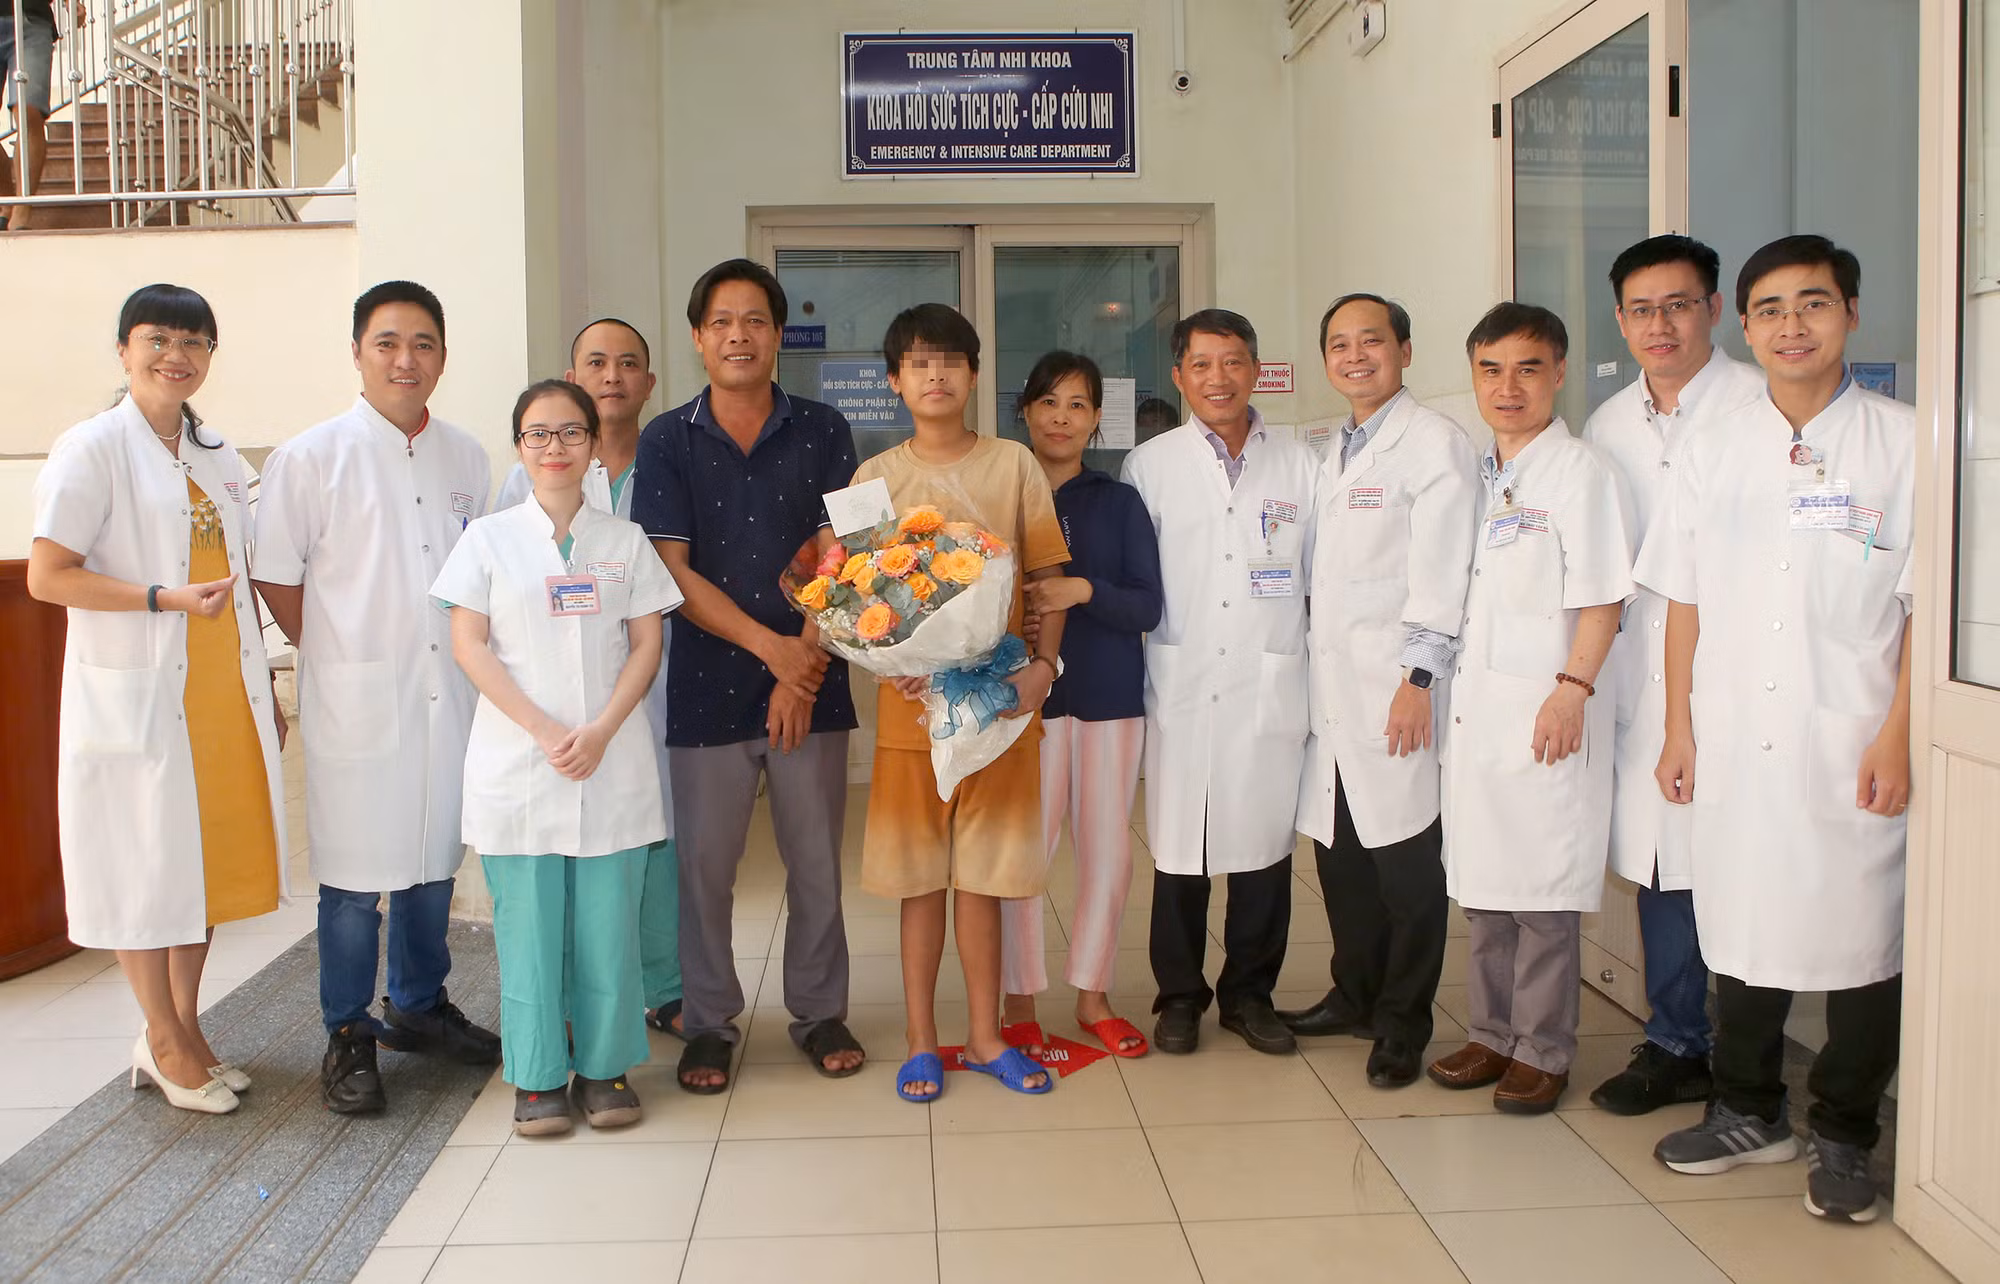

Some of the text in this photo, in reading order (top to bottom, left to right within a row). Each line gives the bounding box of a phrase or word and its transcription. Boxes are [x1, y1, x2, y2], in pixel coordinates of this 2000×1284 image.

[906, 49, 1072, 69] TRUNG TÂM NHI KHOA
[867, 79, 1113, 138] KHOA HỒI SỨC TÍCH CỰC - CẤP CỨU NHI
[870, 144, 1111, 160] EMERGENCY & INTENSIVE CARE DEPARTMENT
[784, 330, 810, 343] PHÒNG
[859, 369, 877, 378] KHOA
[1271, 368, 1290, 378] THUỐC
[1258, 380, 1286, 388] SMOKING
[838, 396, 899, 409] KHÔNG PHẬN SỰ
[843, 411, 857, 421] XIN
[879, 410, 895, 421] VÀO
